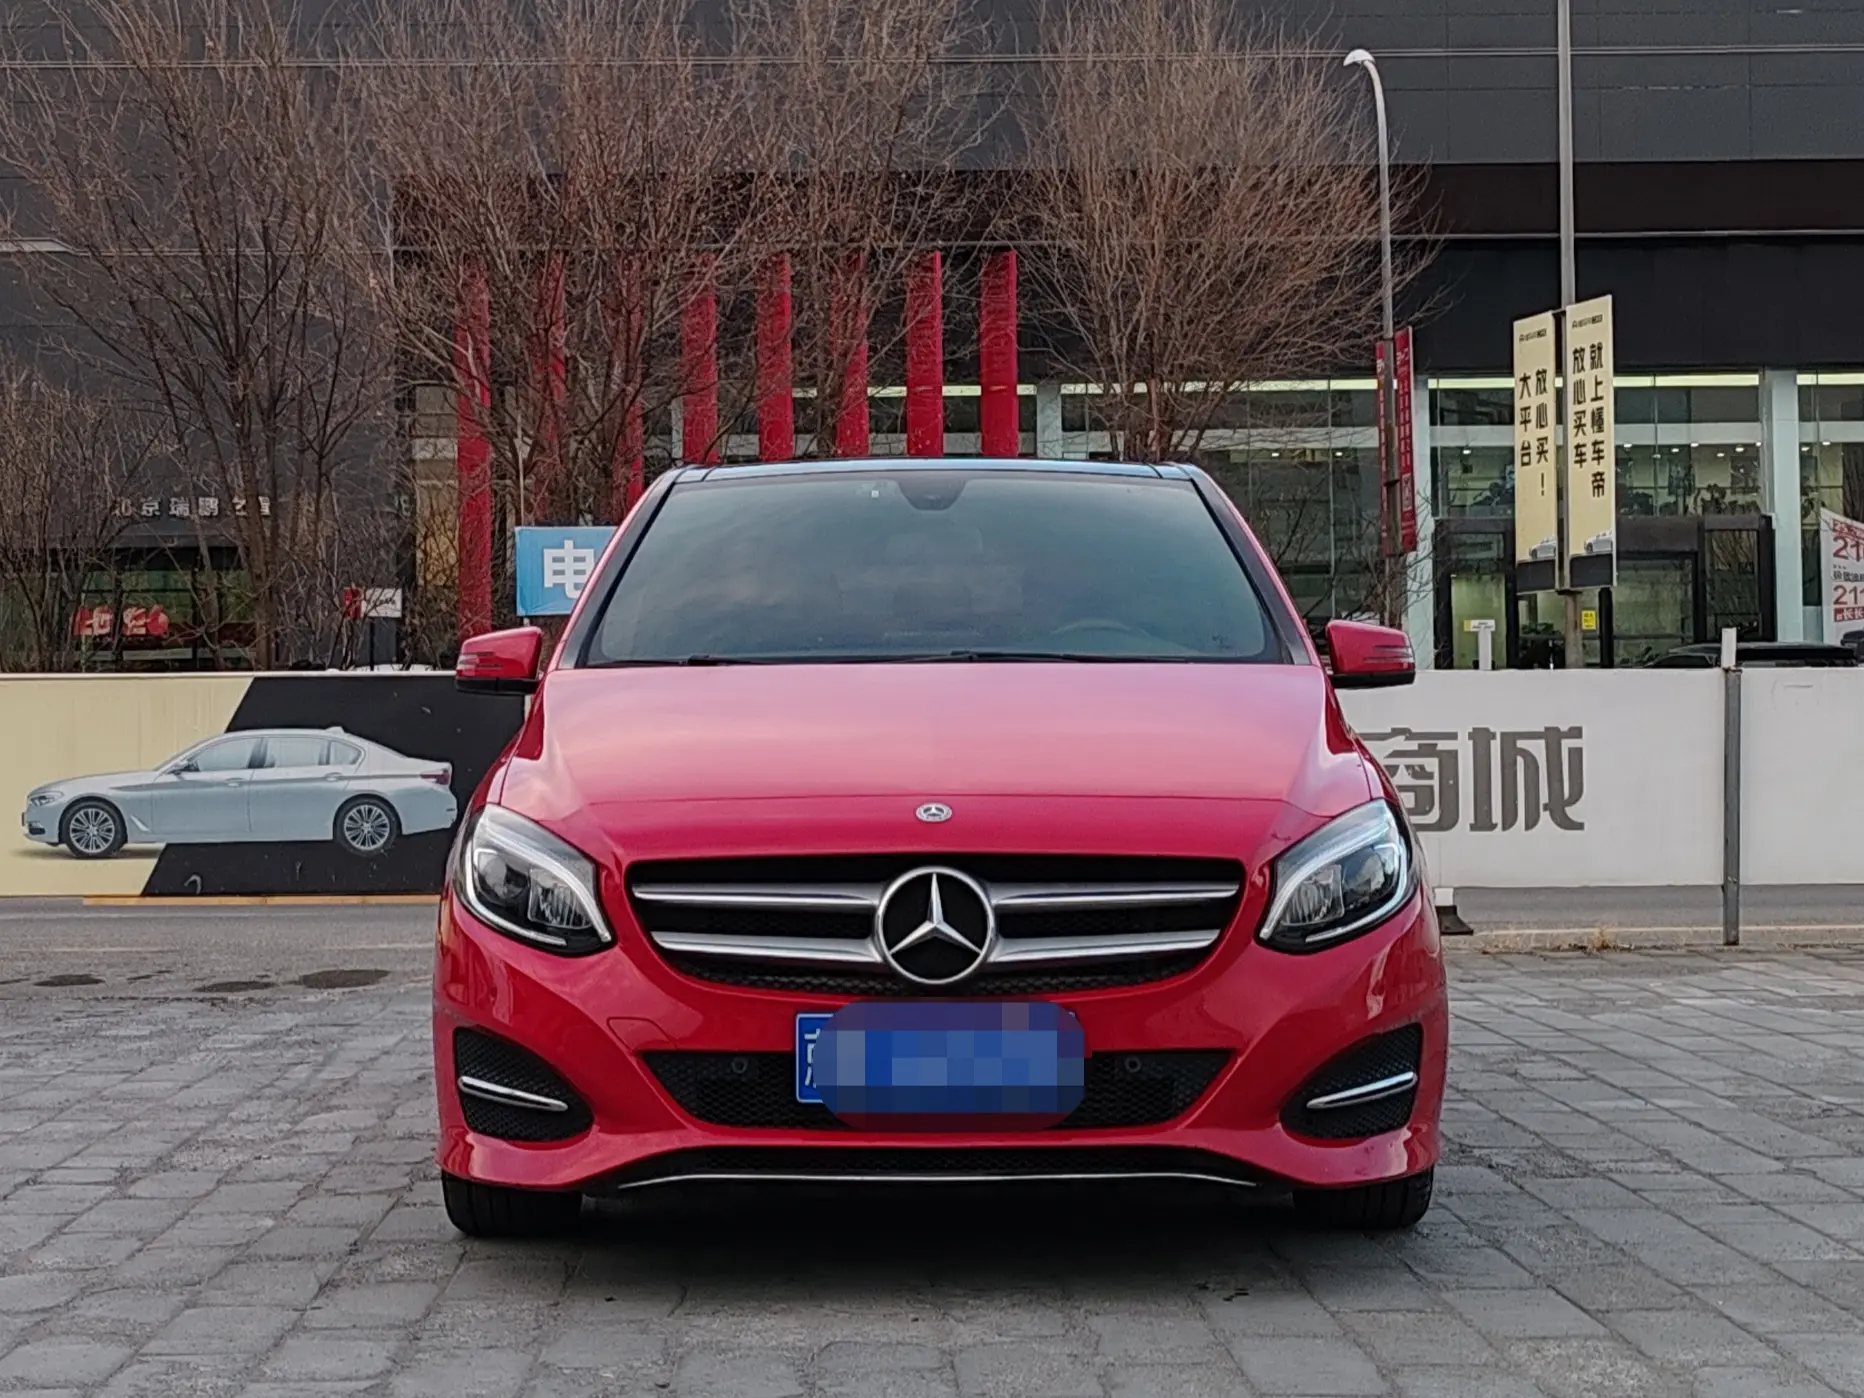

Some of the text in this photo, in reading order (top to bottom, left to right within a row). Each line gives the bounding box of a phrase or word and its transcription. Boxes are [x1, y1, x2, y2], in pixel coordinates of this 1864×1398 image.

[1519, 372, 1532, 467] 大平台
[1535, 368, 1549, 496] 放心买！
[1572, 347, 1587, 469] 放心买车
[1590, 342, 1605, 498] 就上懂车帝
[544, 540, 595, 599] 电
[1832, 536, 1864, 562] 21
[1358, 726, 1585, 831] 商城
